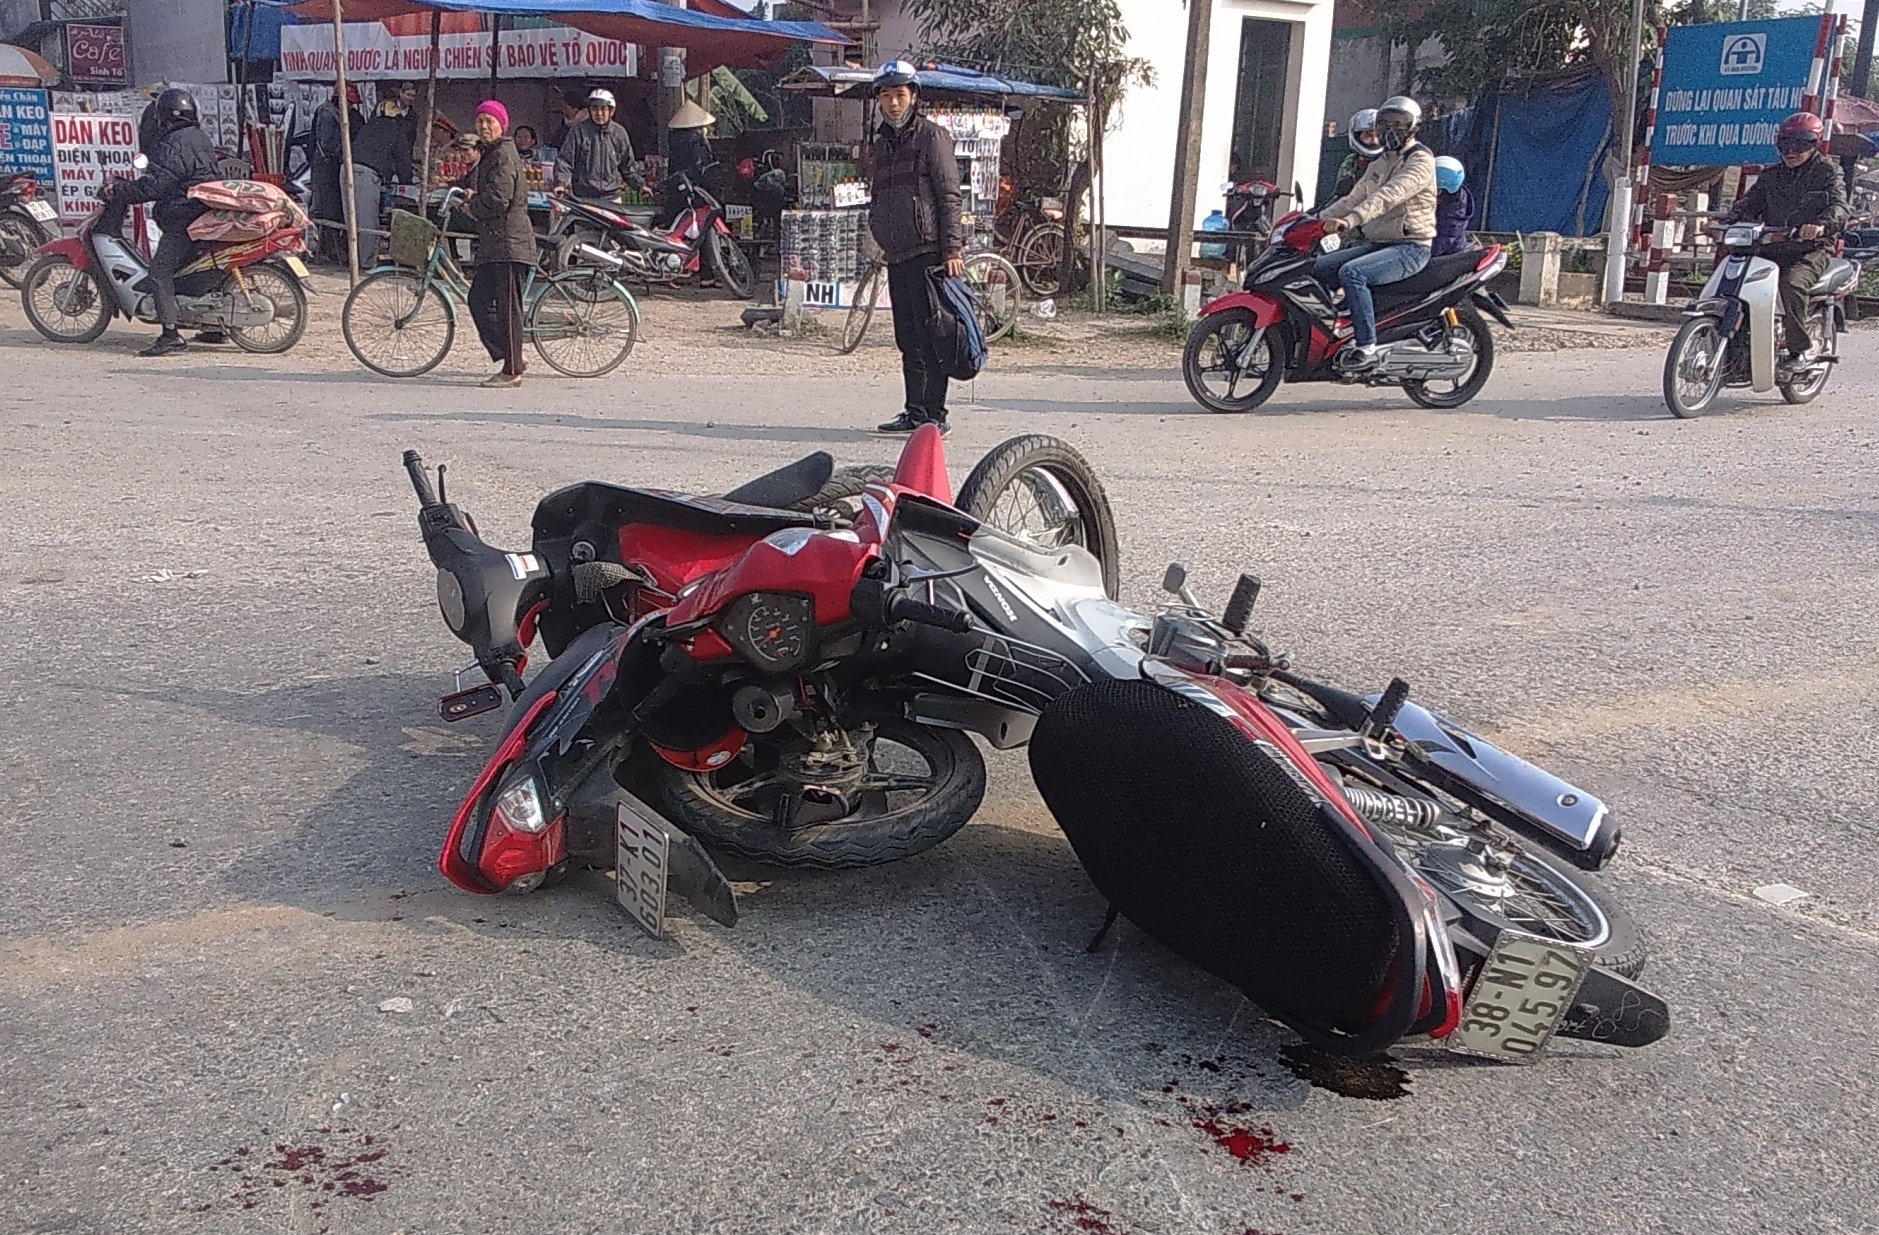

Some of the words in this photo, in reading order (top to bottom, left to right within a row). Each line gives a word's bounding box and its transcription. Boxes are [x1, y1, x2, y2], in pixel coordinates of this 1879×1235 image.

[308, 50, 339, 73] QUAN
[384, 44, 400, 71] LÀ
[445, 38, 482, 69] CHIẾN
[507, 34, 536, 68] BẢO
[539, 38, 559, 72] VỆ
[562, 32, 582, 66] TỔ
[90, 66, 110, 75] Sinh
[16, 105, 45, 119] KEO
[1694, 90, 1711, 115] LẠI
[1712, 88, 1743, 112] QUAN
[1743, 83, 1766, 109] SÁT
[1767, 83, 1789, 109] TÀU
[0, 122, 13, 150] E
[21, 122, 47, 136] MÁY
[55, 116, 93, 145] DÁN
[98, 120, 133, 146] KEO
[1665, 118, 1697, 145] TRƯỚC
[1697, 124, 1717, 146] KHI
[1718, 123, 1739, 147] QUA
[17, 154, 52, 165] THOẠI
[58, 147, 91, 165] ĐIỆN
[61, 166, 95, 181] MÁY
[62, 183, 79, 197] ÉP
[64, 200, 100, 213] KÍNH
[806, 283, 834, 304] NH
[984, 574, 1018, 622] HONDA
[619, 820, 640, 902] 37-K1
[639, 828, 663, 930] 603.01
[1463, 952, 1536, 1038] 38-N1
[1501, 950, 1581, 1054] 045.97
